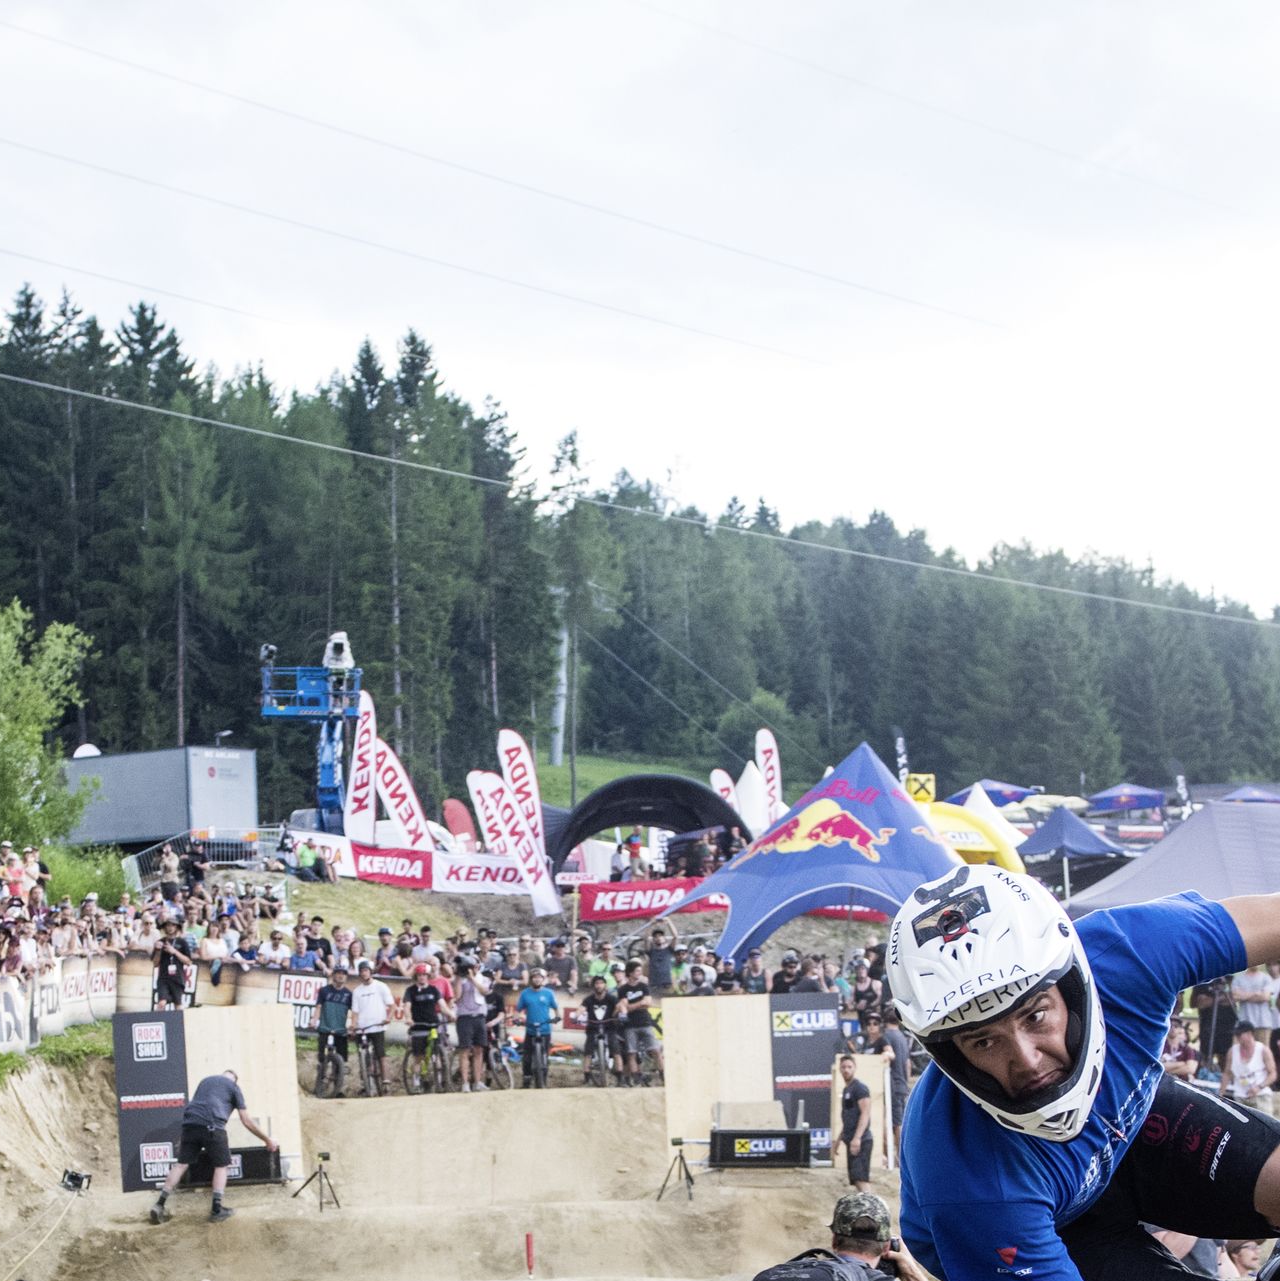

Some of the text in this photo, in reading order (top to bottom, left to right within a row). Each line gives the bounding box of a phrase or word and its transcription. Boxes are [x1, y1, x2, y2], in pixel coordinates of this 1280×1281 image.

[358, 855, 423, 879] KENDA
[992, 872, 1030, 902] SONY
[593, 888, 687, 911] KENDA
[891, 921, 902, 967] SONY
[926, 964, 1027, 1021] XPERIA
[791, 1012, 835, 1029] CLUB
[137, 1028, 161, 1040] ROCK
[138, 1043, 163, 1057] SHOX
[145, 1148, 169, 1160] ROCK
[750, 1140, 785, 1152] CLUB
[1209, 1130, 1231, 1181] DAINESE
